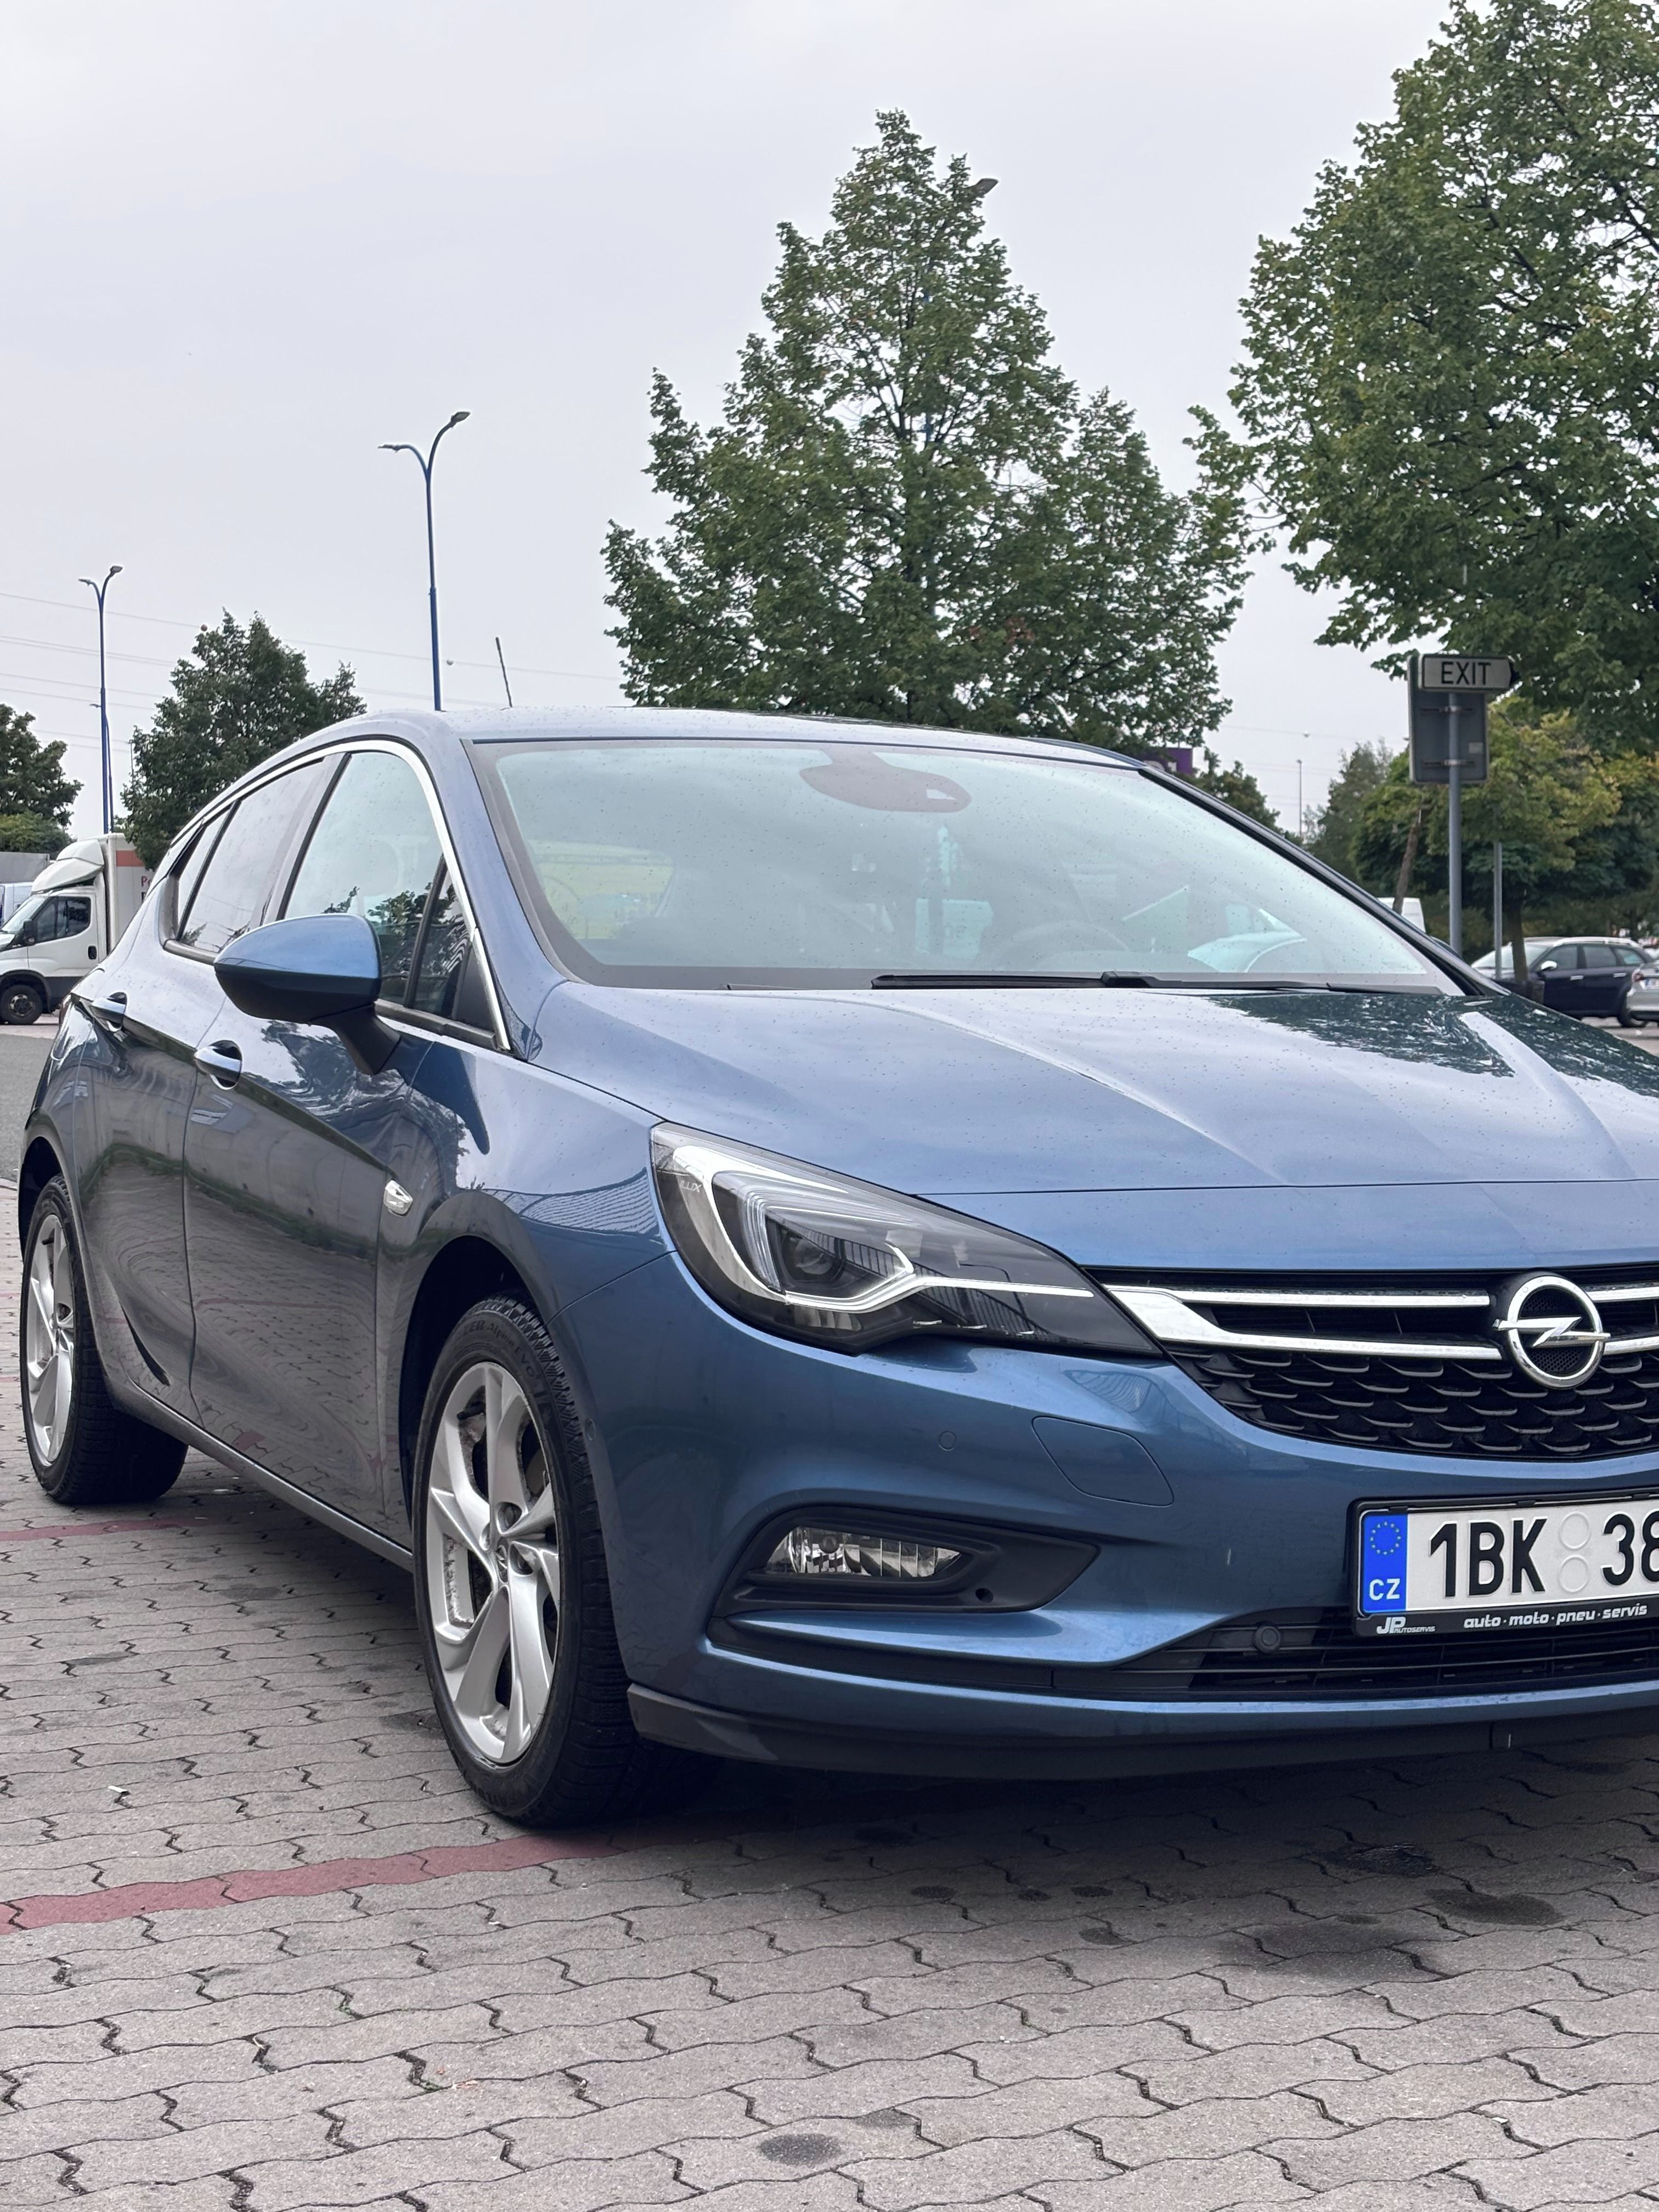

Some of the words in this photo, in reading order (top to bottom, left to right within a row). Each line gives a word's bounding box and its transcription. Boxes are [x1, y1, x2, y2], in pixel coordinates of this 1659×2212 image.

[1441, 661, 1491, 685] EXIT
[1430, 1517, 1548, 1598] 1BK
[1369, 1578, 1400, 1601] CZ
[1601, 1602, 1648, 1619] servis
